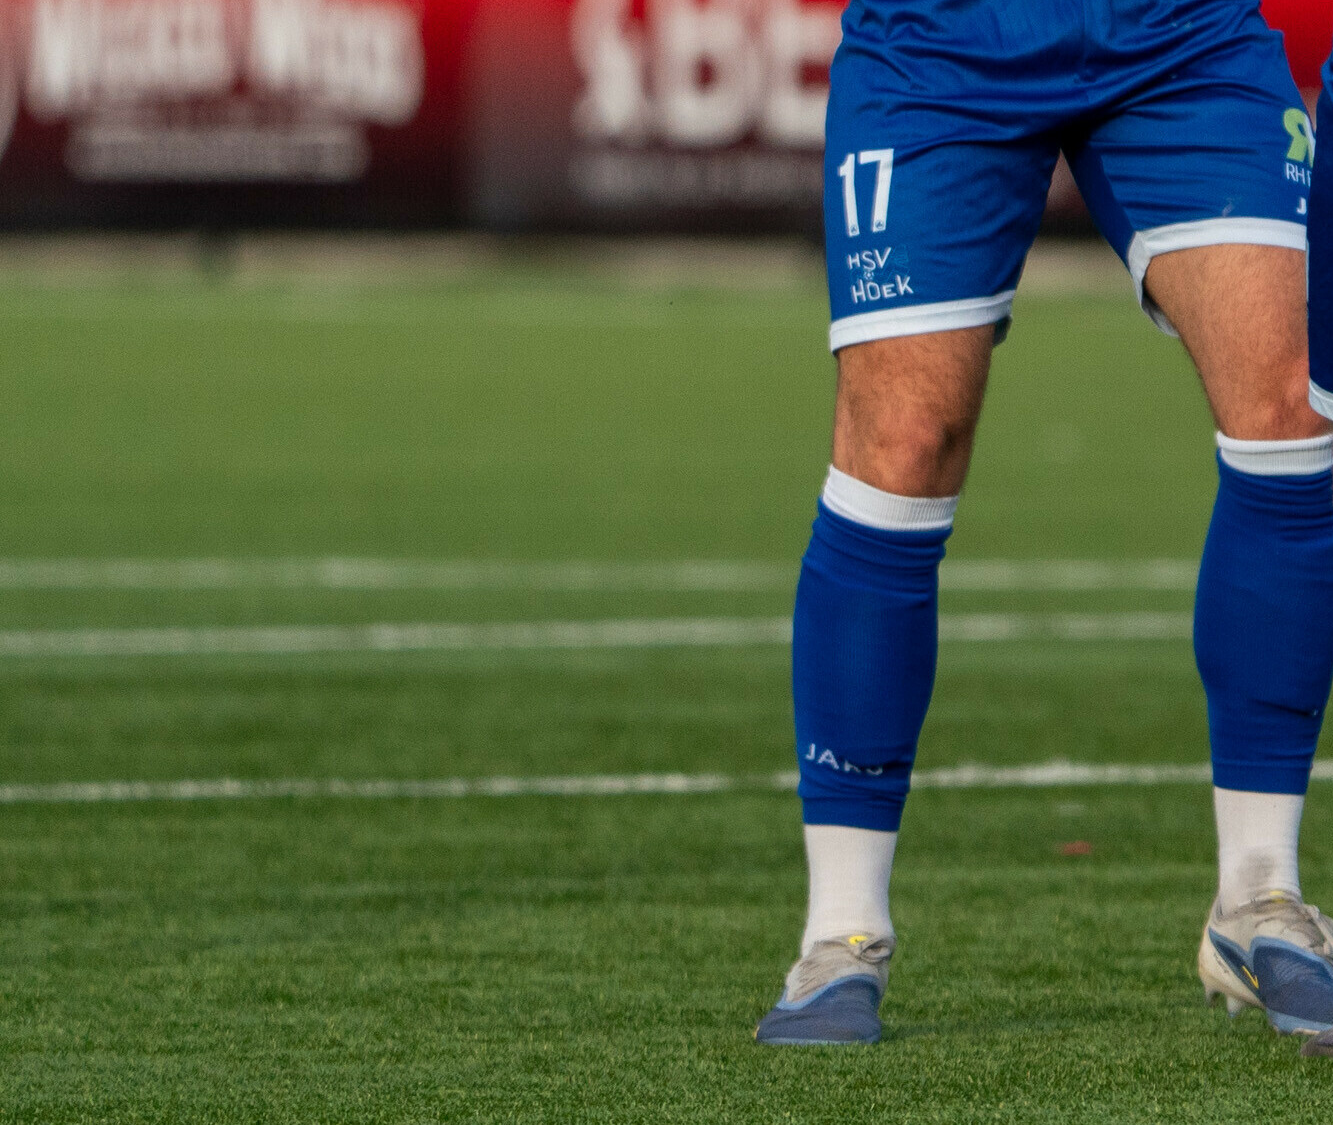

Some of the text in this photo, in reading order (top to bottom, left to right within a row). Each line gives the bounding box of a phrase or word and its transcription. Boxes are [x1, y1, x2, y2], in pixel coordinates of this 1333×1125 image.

[837, 147, 895, 238] 17
[847, 246, 892, 271] HSV
[805, 742, 883, 776] JA
